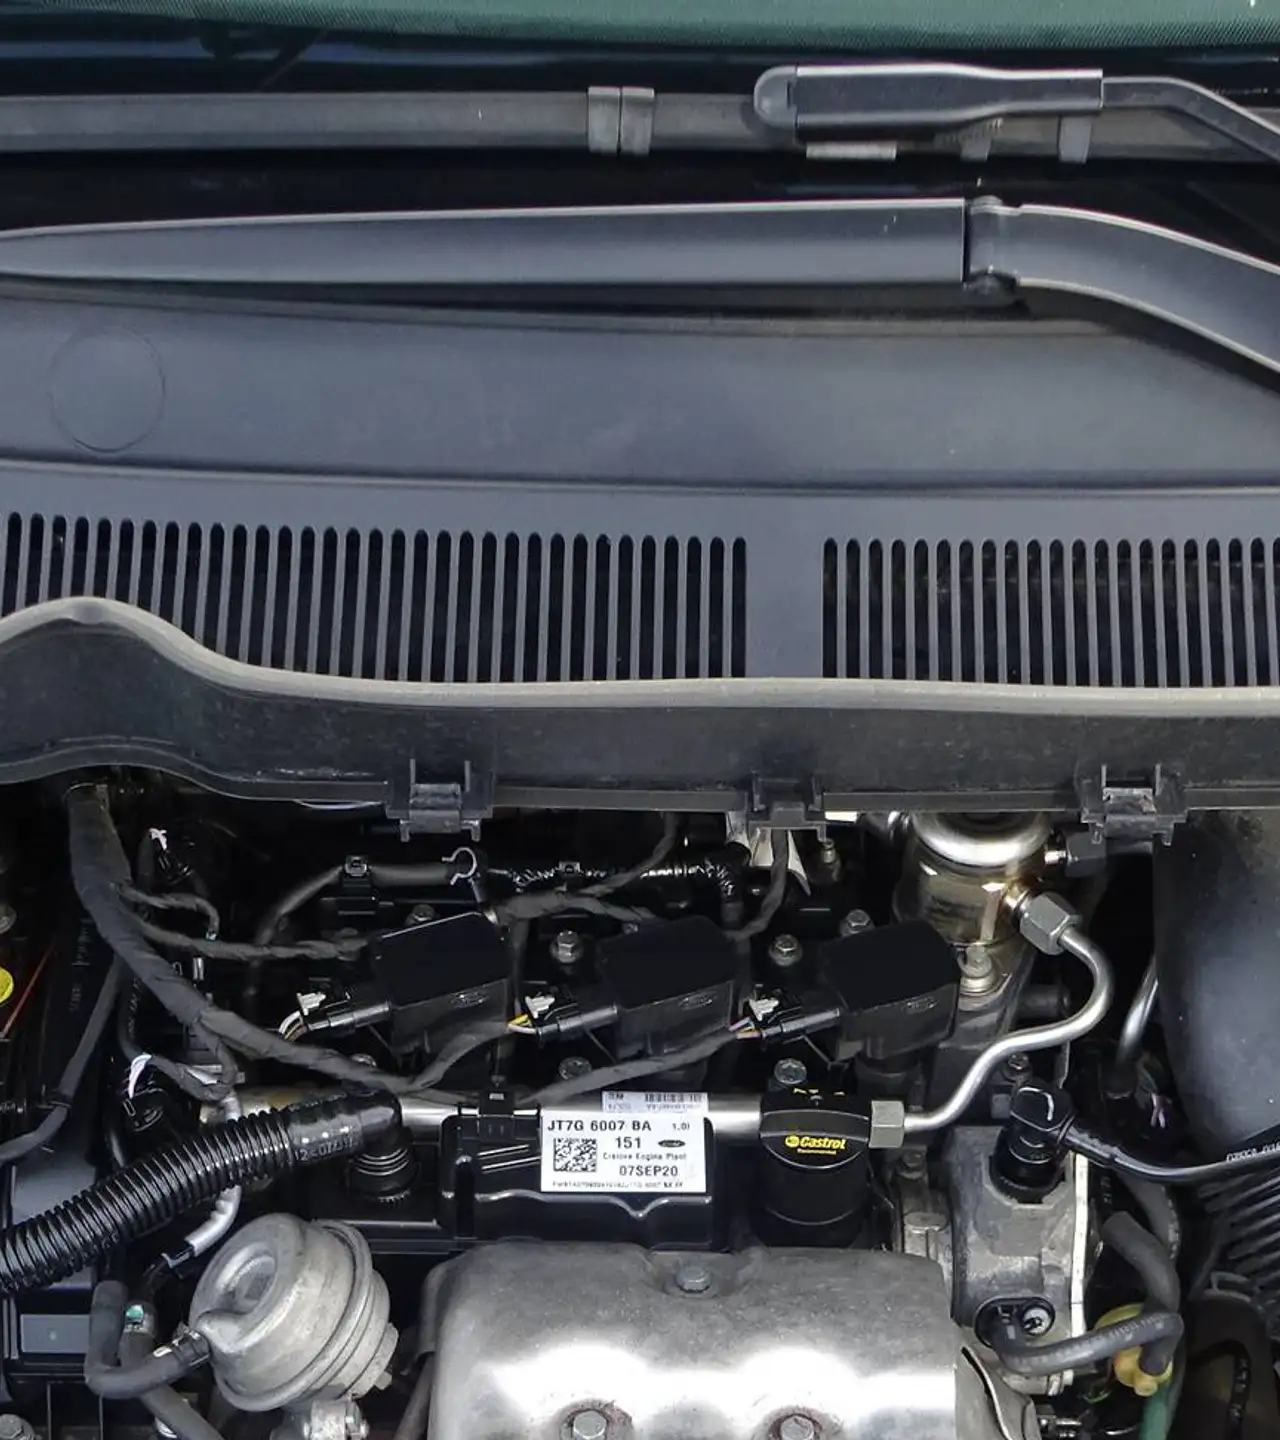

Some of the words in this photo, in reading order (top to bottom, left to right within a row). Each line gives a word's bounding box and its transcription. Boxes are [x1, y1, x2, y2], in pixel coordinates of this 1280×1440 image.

[548, 1120, 584, 1132] JT7G
[590, 1120, 626, 1132] 6007
[632, 1120, 651, 1132] BA
[615, 1136, 641, 1149] 151
[800, 1136, 846, 1149] Castrol
[635, 1153, 662, 1161] Engine
[619, 1165, 679, 1177] 07SEP20
